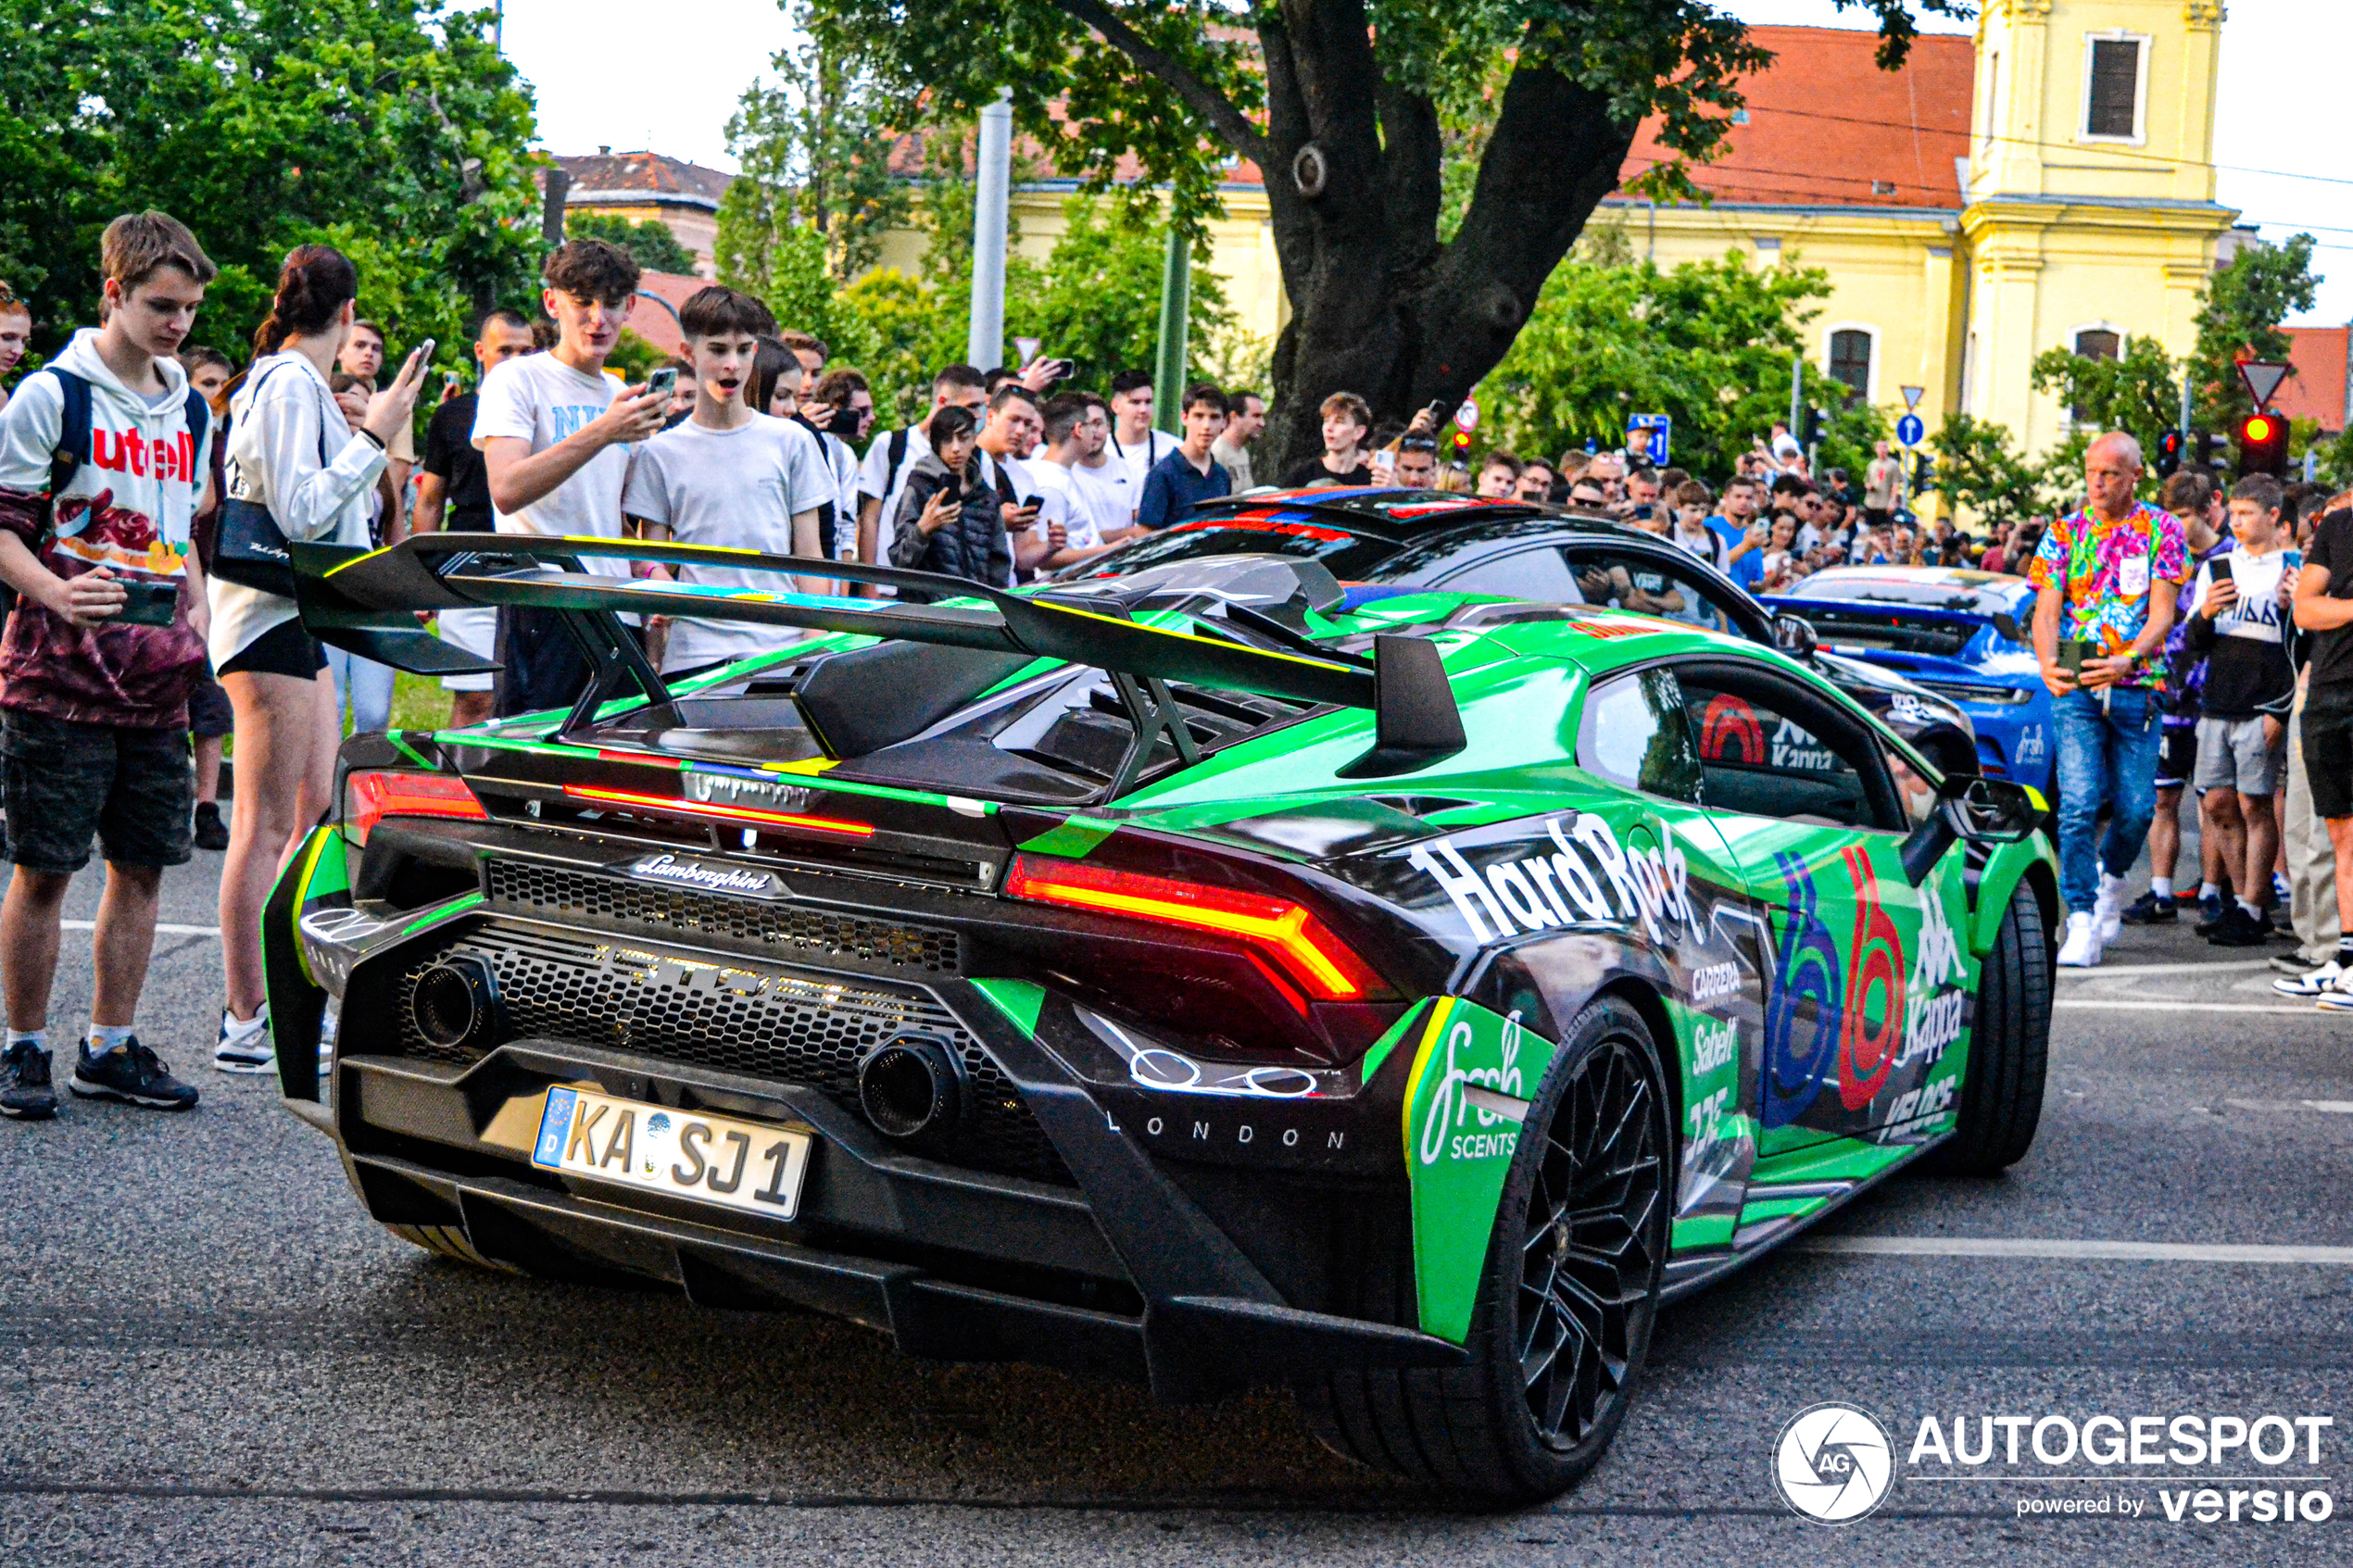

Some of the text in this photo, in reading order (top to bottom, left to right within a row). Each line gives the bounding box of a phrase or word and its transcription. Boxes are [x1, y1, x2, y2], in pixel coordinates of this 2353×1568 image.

[635, 854, 772, 891] Lamborghini
[1406, 812, 1705, 946] Hard Rock
[1692, 960, 1742, 1001] CARRERA
[1902, 988, 1963, 1065] Kappa
[1106, 1110, 1344, 1149] LONDON
[1876, 1074, 1957, 1144] VELOCE
[545, 1135, 558, 1152] D
[566, 1100, 636, 1173] KA
[1450, 1132, 1517, 1160] SCENTS
